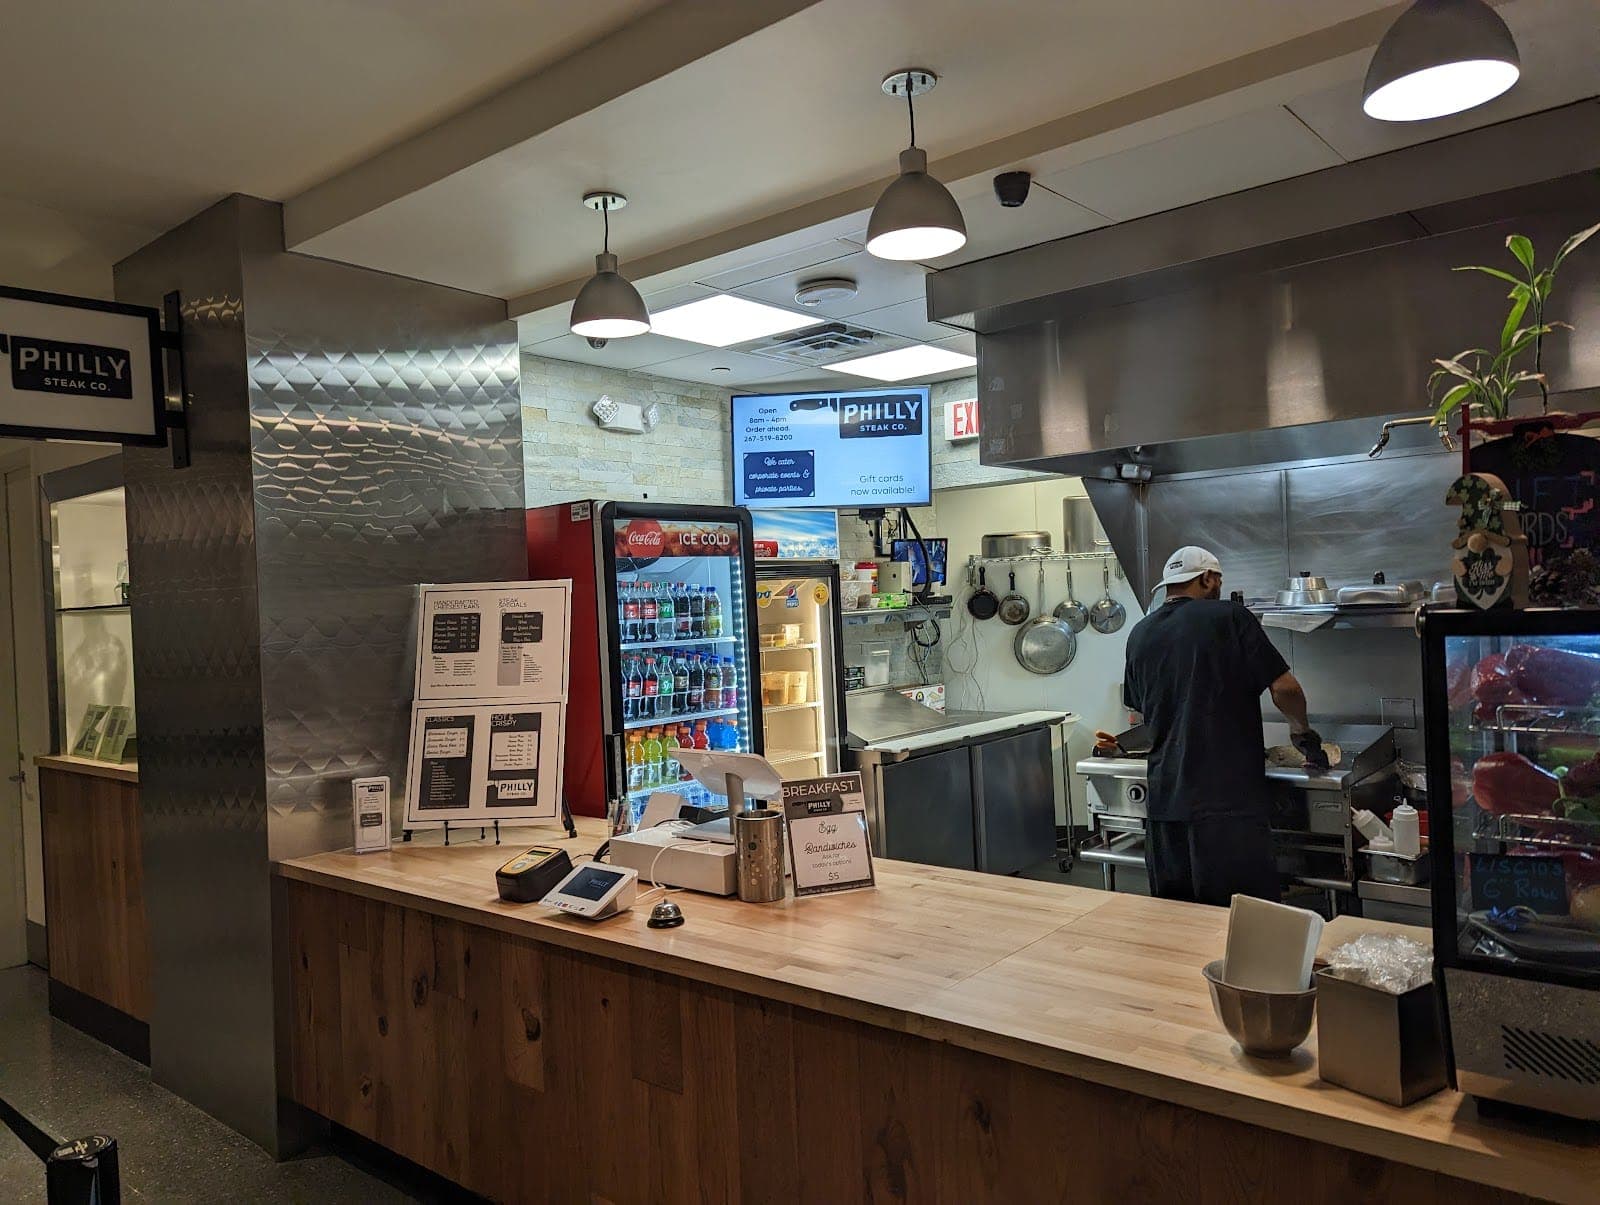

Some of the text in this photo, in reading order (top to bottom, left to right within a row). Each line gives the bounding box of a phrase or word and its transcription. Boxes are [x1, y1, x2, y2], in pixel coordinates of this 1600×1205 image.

[19, 347, 126, 379] PHILLY
[44, 377, 111, 391] STEAK CO.
[844, 400, 920, 424] PHILLY
[953, 402, 979, 435] EXI
[860, 423, 907, 432] STEAK CO.
[802, 469, 810, 479] &
[860, 475, 904, 484] Gift cards
[871, 486, 916, 496] available!
[679, 533, 730, 546] ICE COLD
[500, 782, 533, 793] PHILLY
[783, 780, 855, 798] BREAKFAST
[808, 800, 832, 810] PHILLY
[818, 821, 838, 834] Egg
[804, 841, 857, 854] Sandwiches
